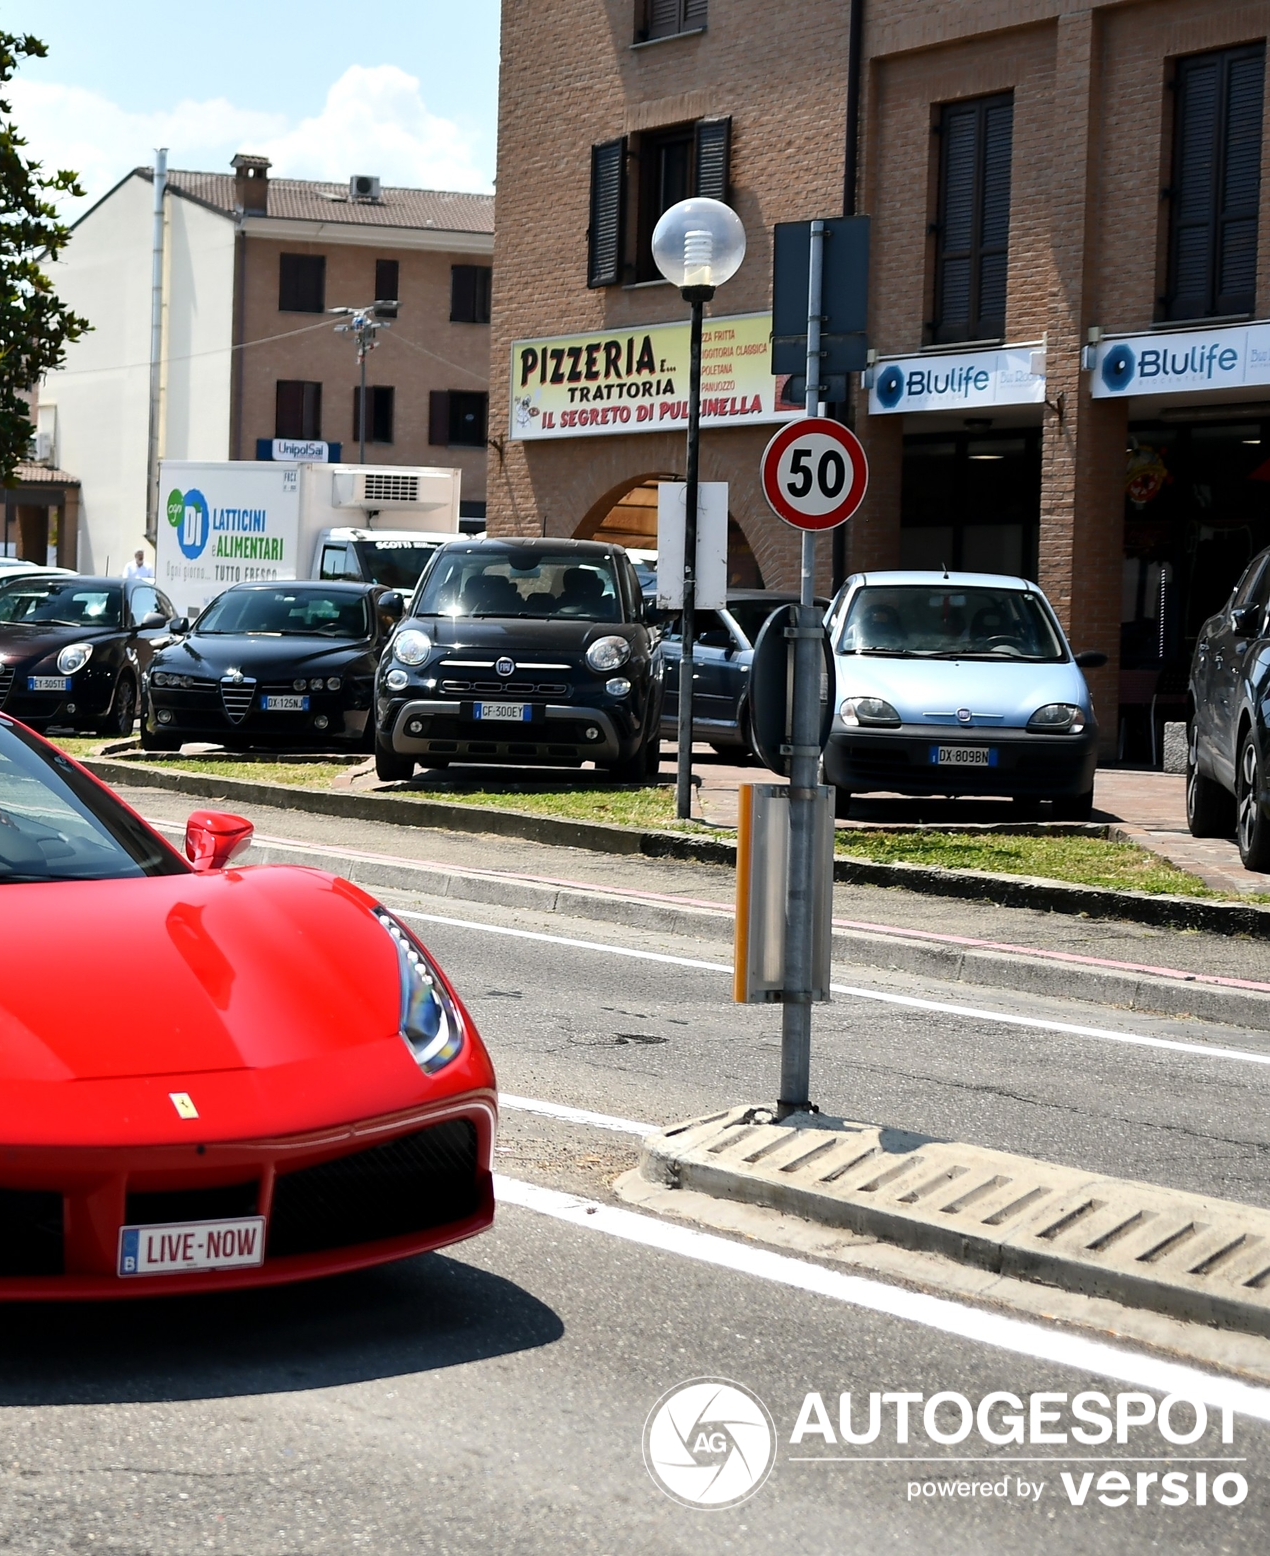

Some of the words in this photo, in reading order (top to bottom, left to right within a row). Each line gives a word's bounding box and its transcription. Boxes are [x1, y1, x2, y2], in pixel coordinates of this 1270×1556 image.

[701, 331, 712, 343] ZZA
[714, 329, 736, 341] FRITTA
[520, 335, 656, 388] PIZZERIA
[735, 343, 767, 356] CLASSICA
[1138, 343, 1238, 379] Blulife
[701, 363, 733, 376] POLETANA
[906, 366, 990, 398] Blulife
[567, 378, 675, 403] TRATTORIA
[541, 411, 556, 429] IL
[560, 402, 631, 428] SEGRETO
[636, 402, 655, 422] DI
[659, 394, 763, 420] PULINELLA
[278, 442, 323, 457] UnipolSai
[787, 449, 845, 498] 50
[212, 508, 266, 532] LATTICINI
[216, 535, 284, 561] ALIMENTARI
[215, 565, 240, 582] TUTTO
[124, 1256, 135, 1272] B
[147, 1228, 257, 1264] LIVE-NOW
